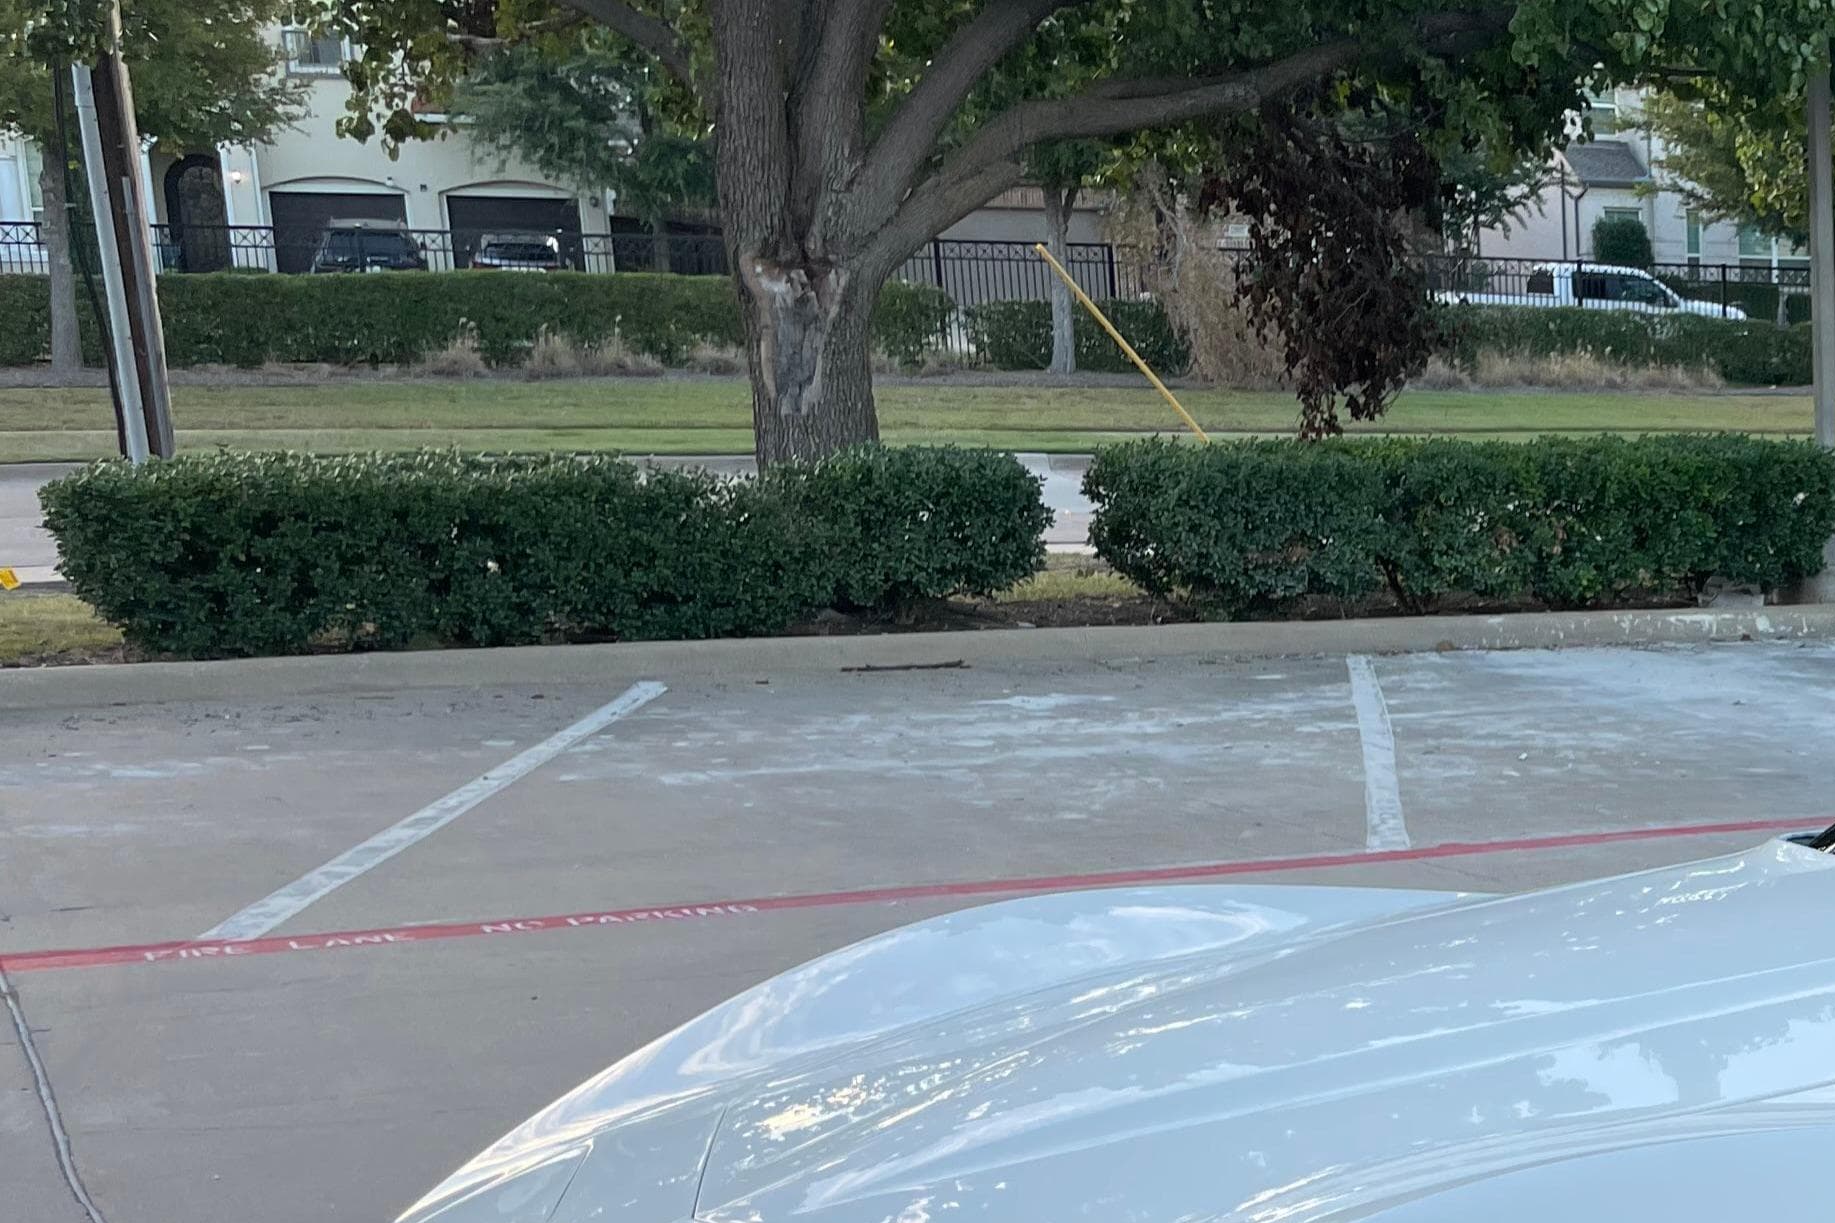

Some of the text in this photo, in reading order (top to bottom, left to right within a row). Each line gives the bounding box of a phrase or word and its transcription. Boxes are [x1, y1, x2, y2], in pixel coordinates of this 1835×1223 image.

[143, 903, 759, 961] FIRE LANE NO PARKING
